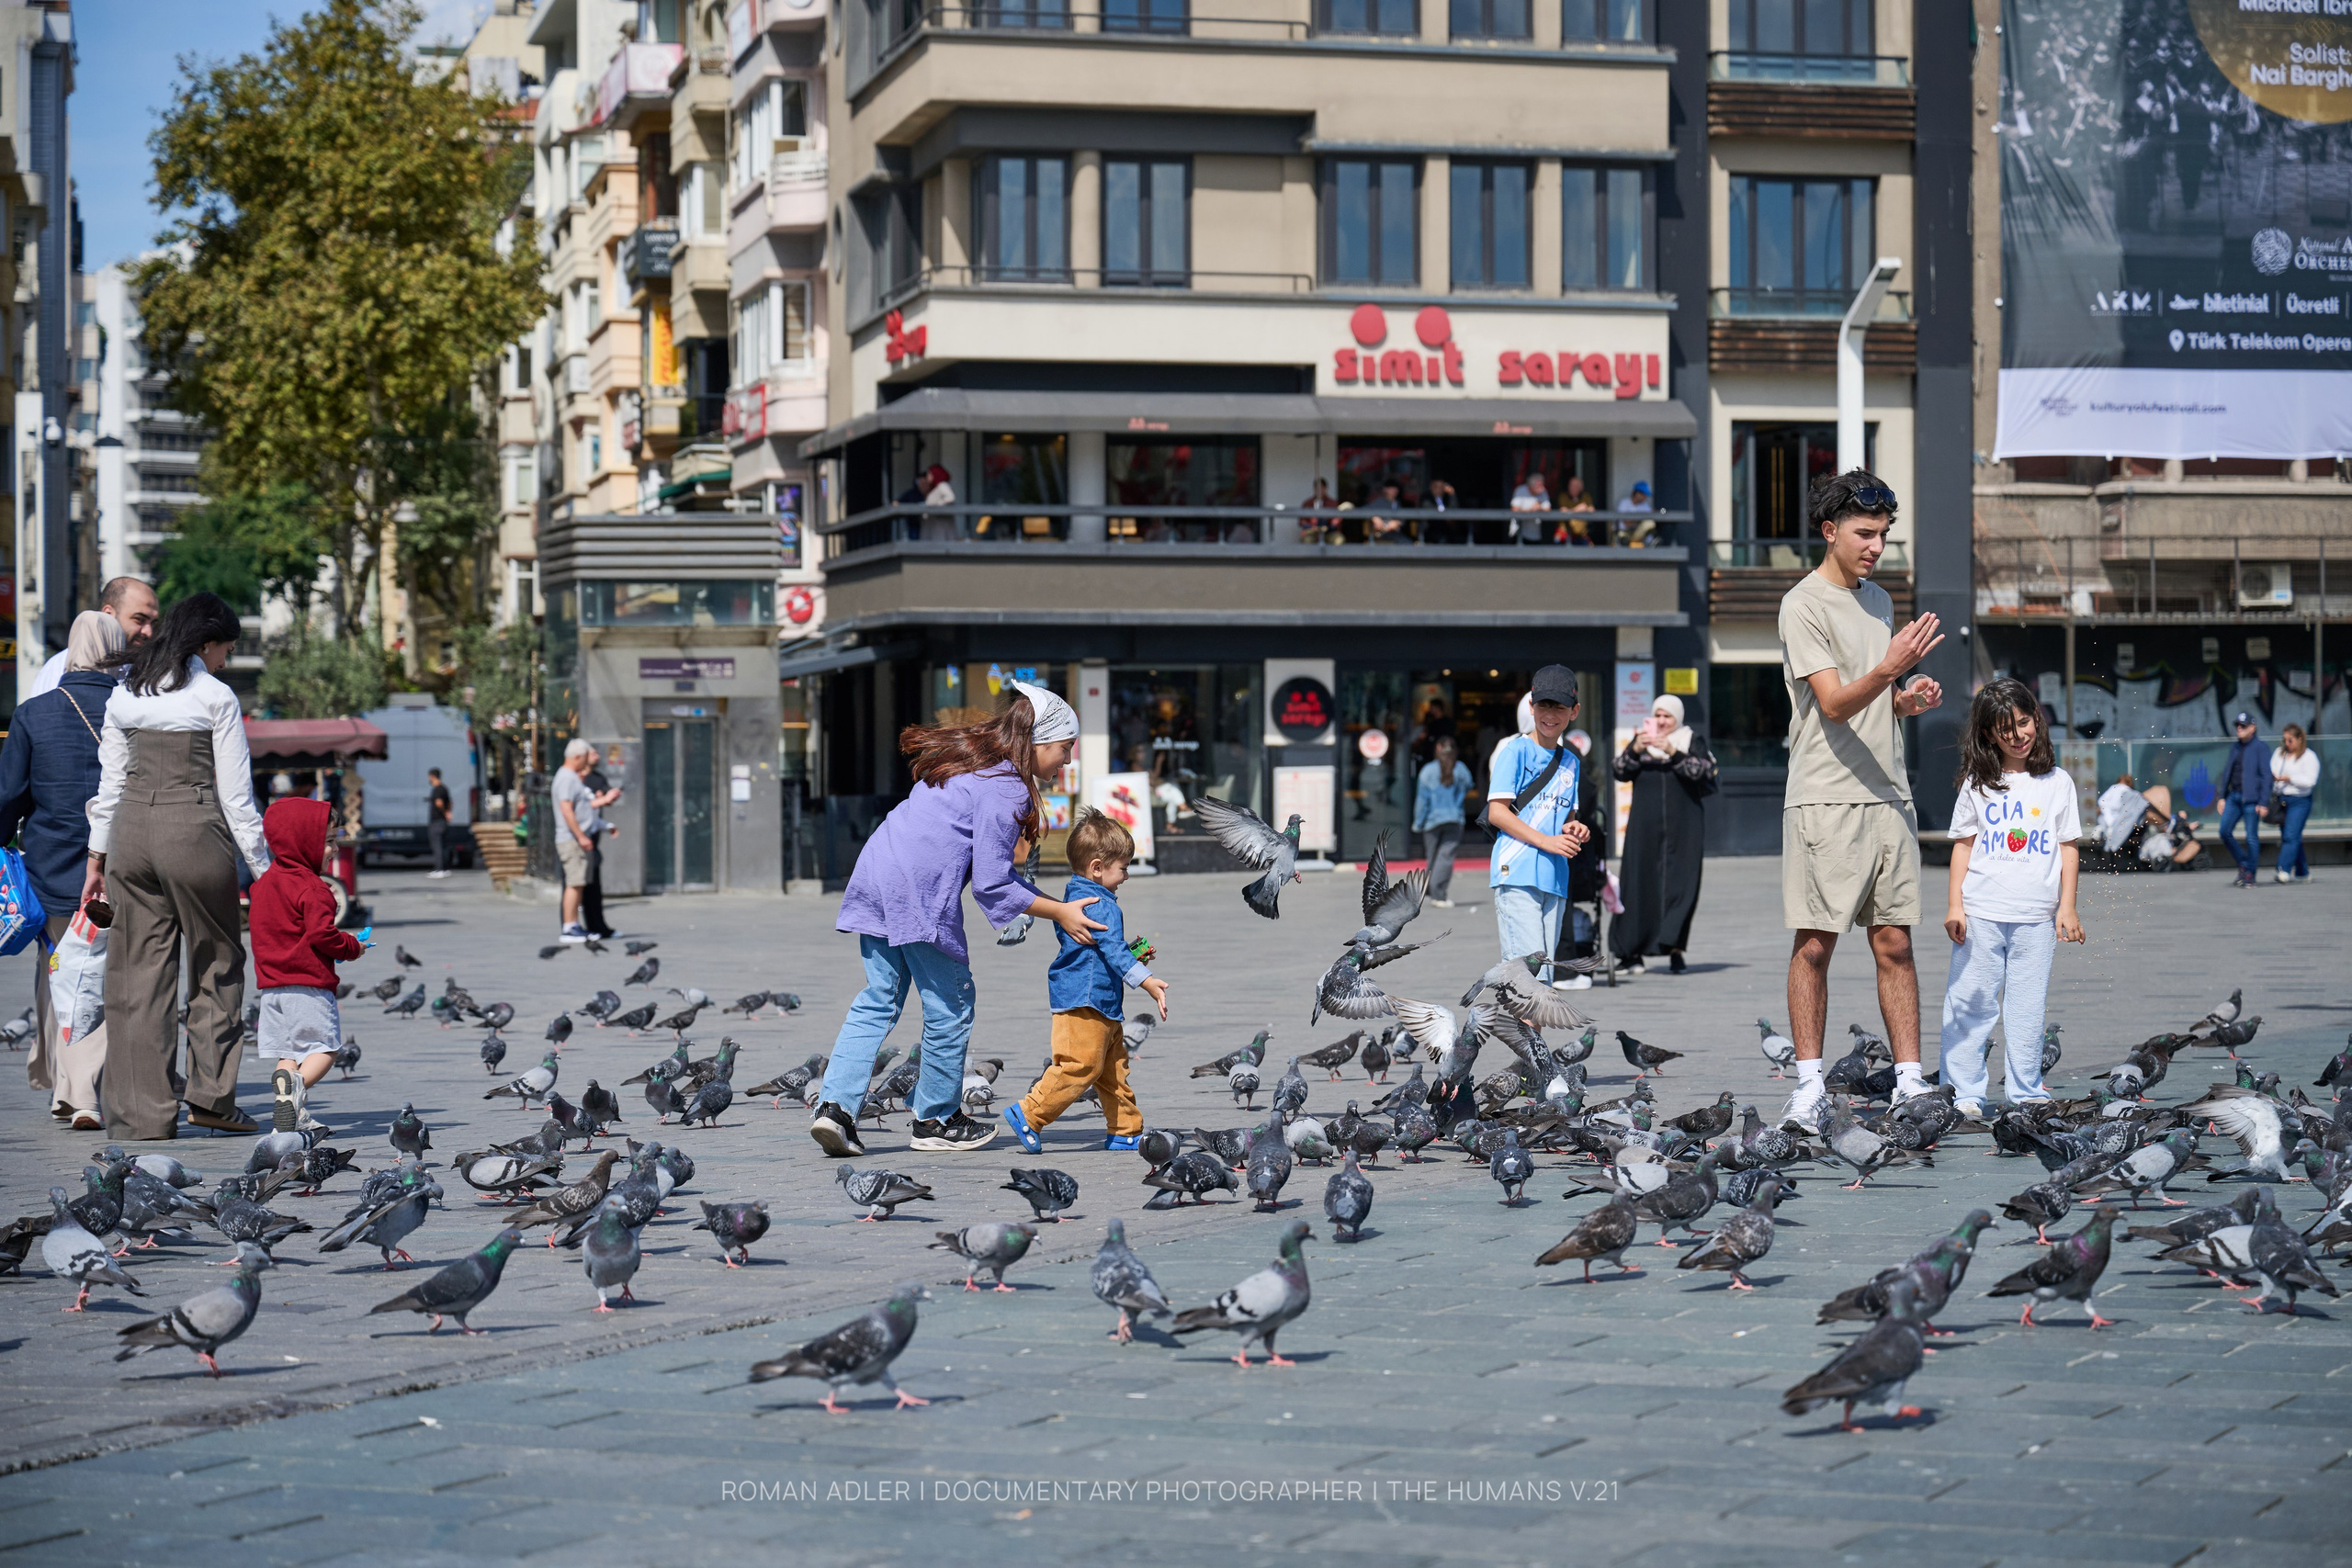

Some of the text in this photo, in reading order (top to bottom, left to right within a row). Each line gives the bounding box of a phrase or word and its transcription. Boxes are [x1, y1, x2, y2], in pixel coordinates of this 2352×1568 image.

[2250, 62, 2352, 91] Nai Bargh
[2203, 292, 2269, 313] biletinial
[2286, 292, 2340, 314] Ücretli
[1334, 303, 1465, 384] simit
[2187, 332, 2352, 353] Türk Telekom Opera
